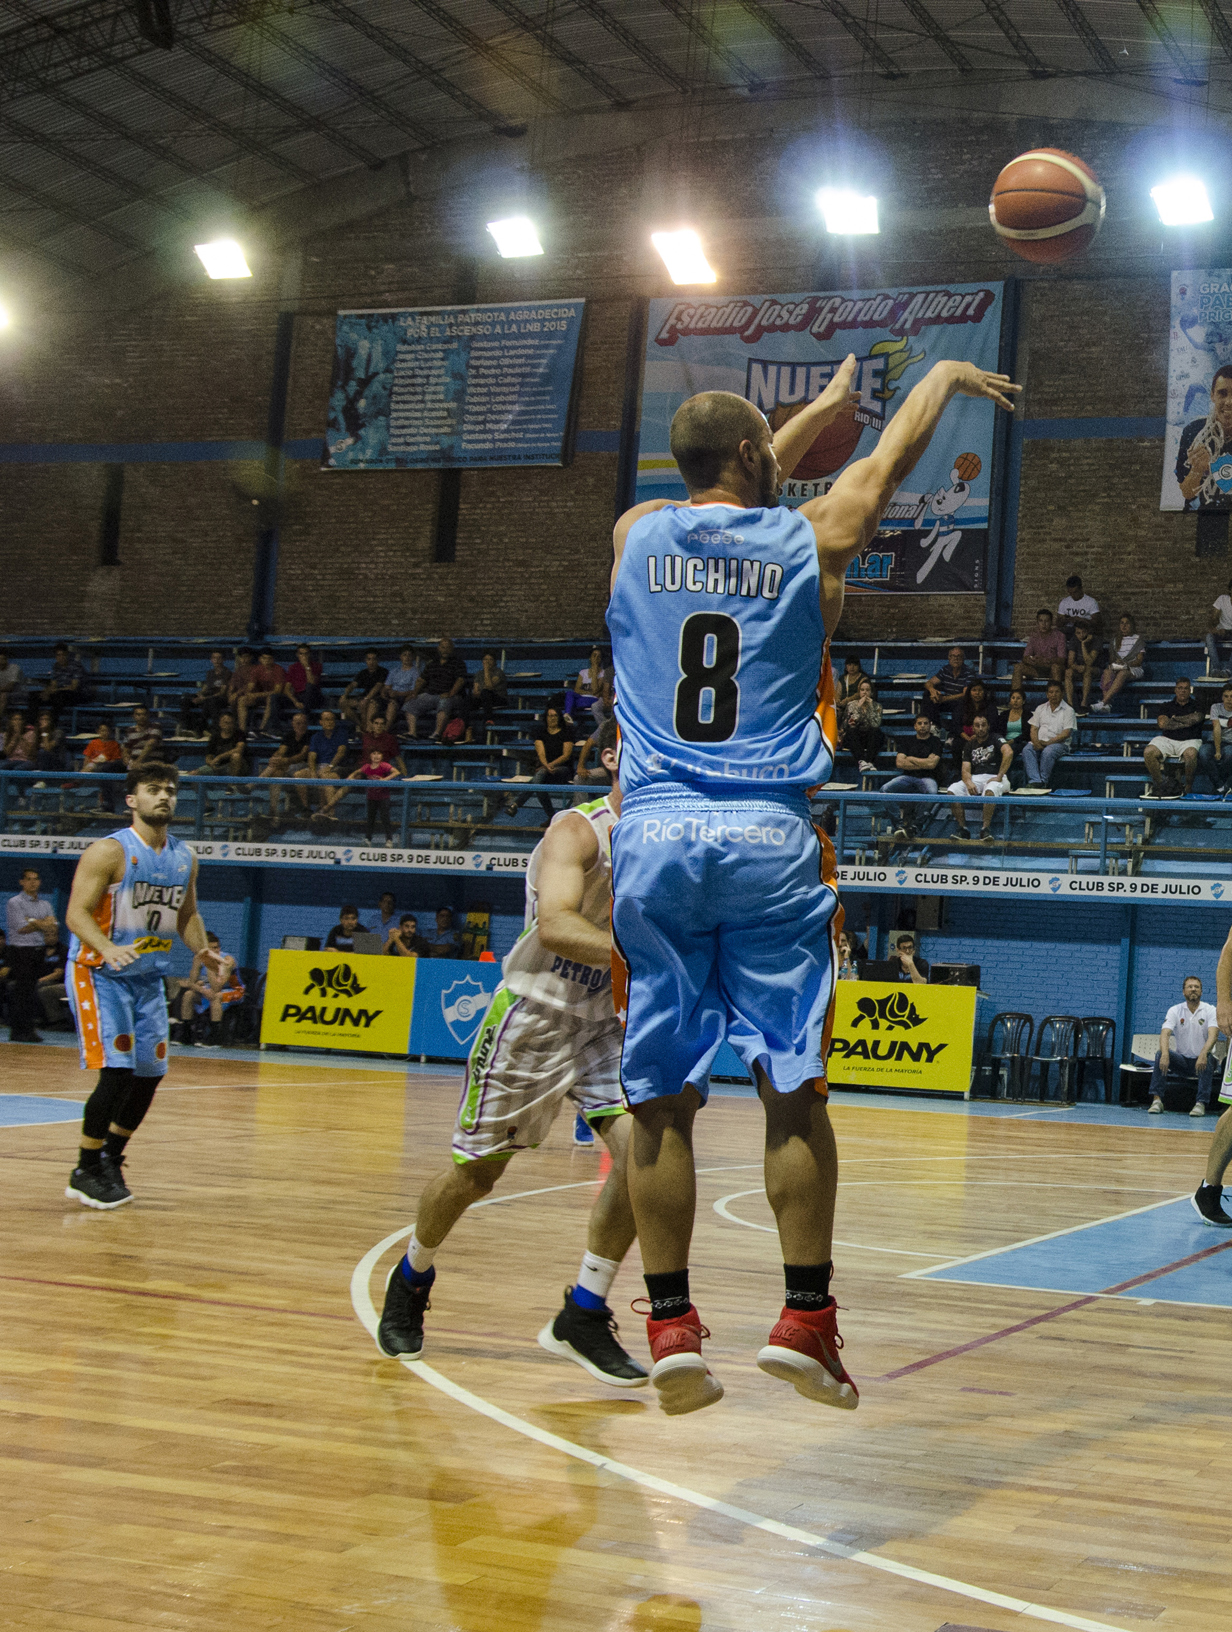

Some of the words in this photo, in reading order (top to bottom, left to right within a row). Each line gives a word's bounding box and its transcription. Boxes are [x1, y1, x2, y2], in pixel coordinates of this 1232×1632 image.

[400, 317, 414, 326] LA
[415, 315, 455, 326] FAMILIA
[457, 312, 506, 324] PATRIOTA
[508, 308, 576, 321] AGRADECIDA
[656, 299, 751, 344] Estadio
[741, 298, 806, 342] José
[890, 288, 992, 335] Albert
[407, 326, 427, 337] POR
[430, 326, 441, 336] EL
[444, 324, 491, 336] ASCENSO
[494, 325, 502, 334] A
[504, 324, 518, 333] LA
[520, 321, 541, 332] LNB
[542, 320, 567, 331] 2015
[854, 411, 870, 424] RIO
[523, 453, 562, 461] INSTITUCI
[647, 553, 783, 601] LUCHINO
[1067, 608, 1086, 616] TWO
[674, 611, 741, 742] 8
[1, 839, 27, 848] CLUB
[197, 845, 213, 855] LIO
[235, 847, 261, 857] CLUB
[264, 848, 279, 858] SP.
[281, 848, 288, 858] 9
[289, 849, 303, 859] DE
[305, 849, 336, 860] JULIO
[359, 852, 386, 862] CLUB
[389, 853, 404, 863] SP.
[405, 853, 414, 864] 9
[416, 854, 430, 864] DE
[433, 854, 465, 866] JULIO
[489, 857, 519, 867] CLUB
[521, 858, 529, 867] S
[836, 871, 848, 881] DE
[850, 871, 886, 882] JULIO
[915, 873, 948, 884] CLUB
[952, 874, 969, 885] SP.
[972, 875, 980, 886] 9
[982, 876, 1000, 887] DE
[1003, 877, 1040, 888] JULIO
[1069, 881, 1104, 892] CLUB
[1108, 882, 1126, 893] SP.
[1129, 882, 1137, 894] 9
[1140, 883, 1158, 894] DE
[1162, 884, 1202, 896] JULIO
[280, 1004, 383, 1028] PAUNY
[827, 1038, 948, 1063] PAUNY
[769, 1321, 800, 1341] NIKE
[661, 1331, 686, 1351] NIKE
